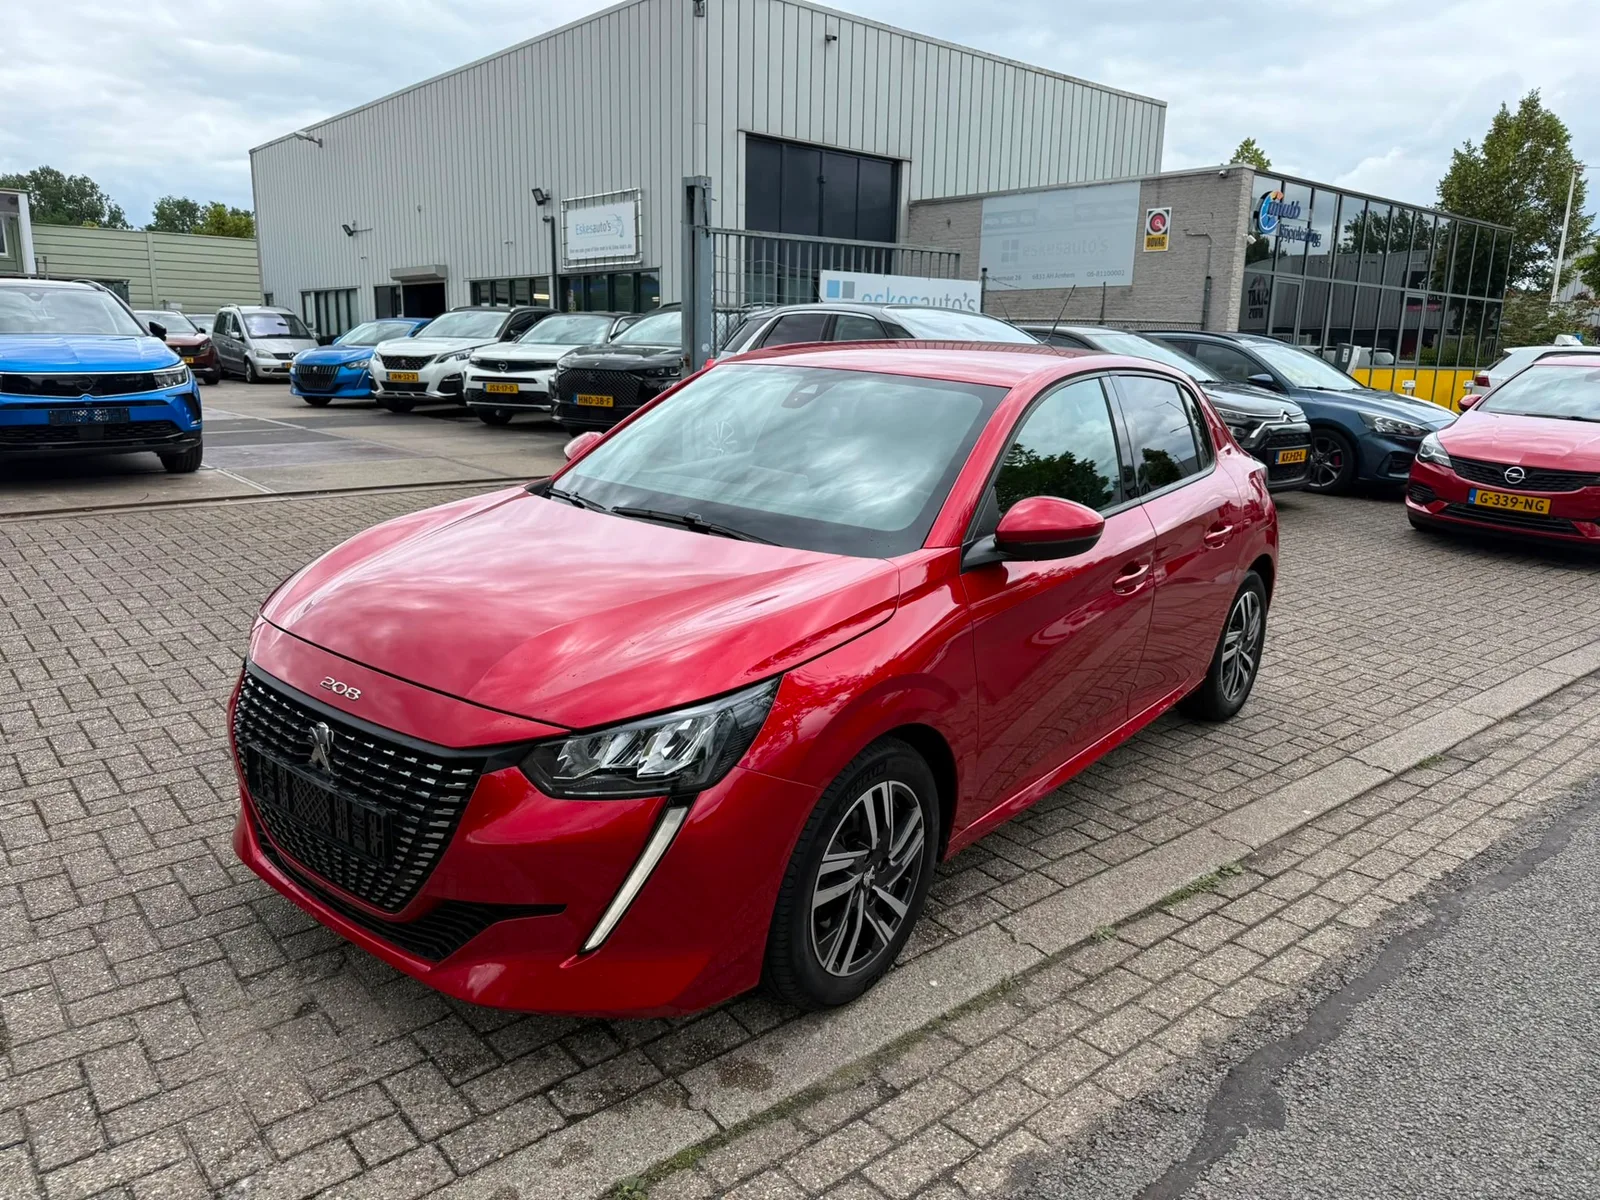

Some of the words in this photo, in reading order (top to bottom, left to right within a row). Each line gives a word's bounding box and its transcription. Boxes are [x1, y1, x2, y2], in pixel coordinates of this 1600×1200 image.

[575, 221, 612, 235] Eskesauto's
[1146, 236, 1166, 248] BOVAG
[578, 396, 612, 405] HND-38-F
[1480, 492, 1545, 512] G-339-NG
[320, 676, 362, 700] 208
